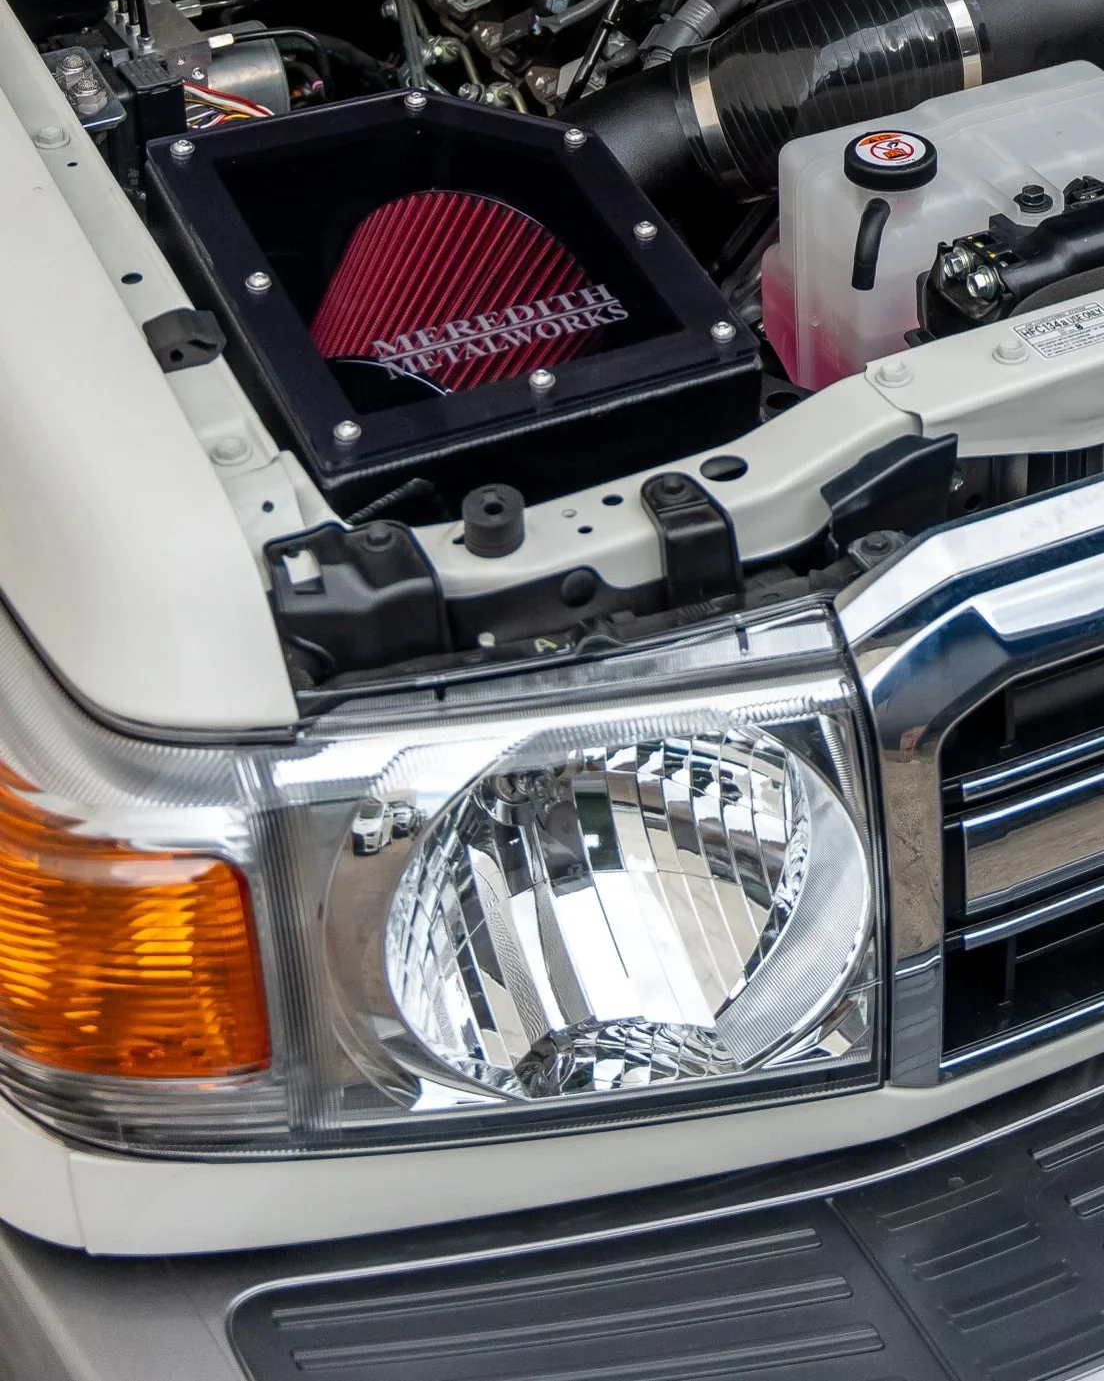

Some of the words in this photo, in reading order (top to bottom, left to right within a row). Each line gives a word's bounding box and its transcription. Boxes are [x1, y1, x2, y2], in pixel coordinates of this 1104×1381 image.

[372, 283, 613, 358] MEREDITH
[384, 303, 629, 380] METALWORKS
[1021, 319, 1068, 338] HFC134a
[1067, 313, 1085, 325] USE
[1082, 307, 1103, 319] ONLY
